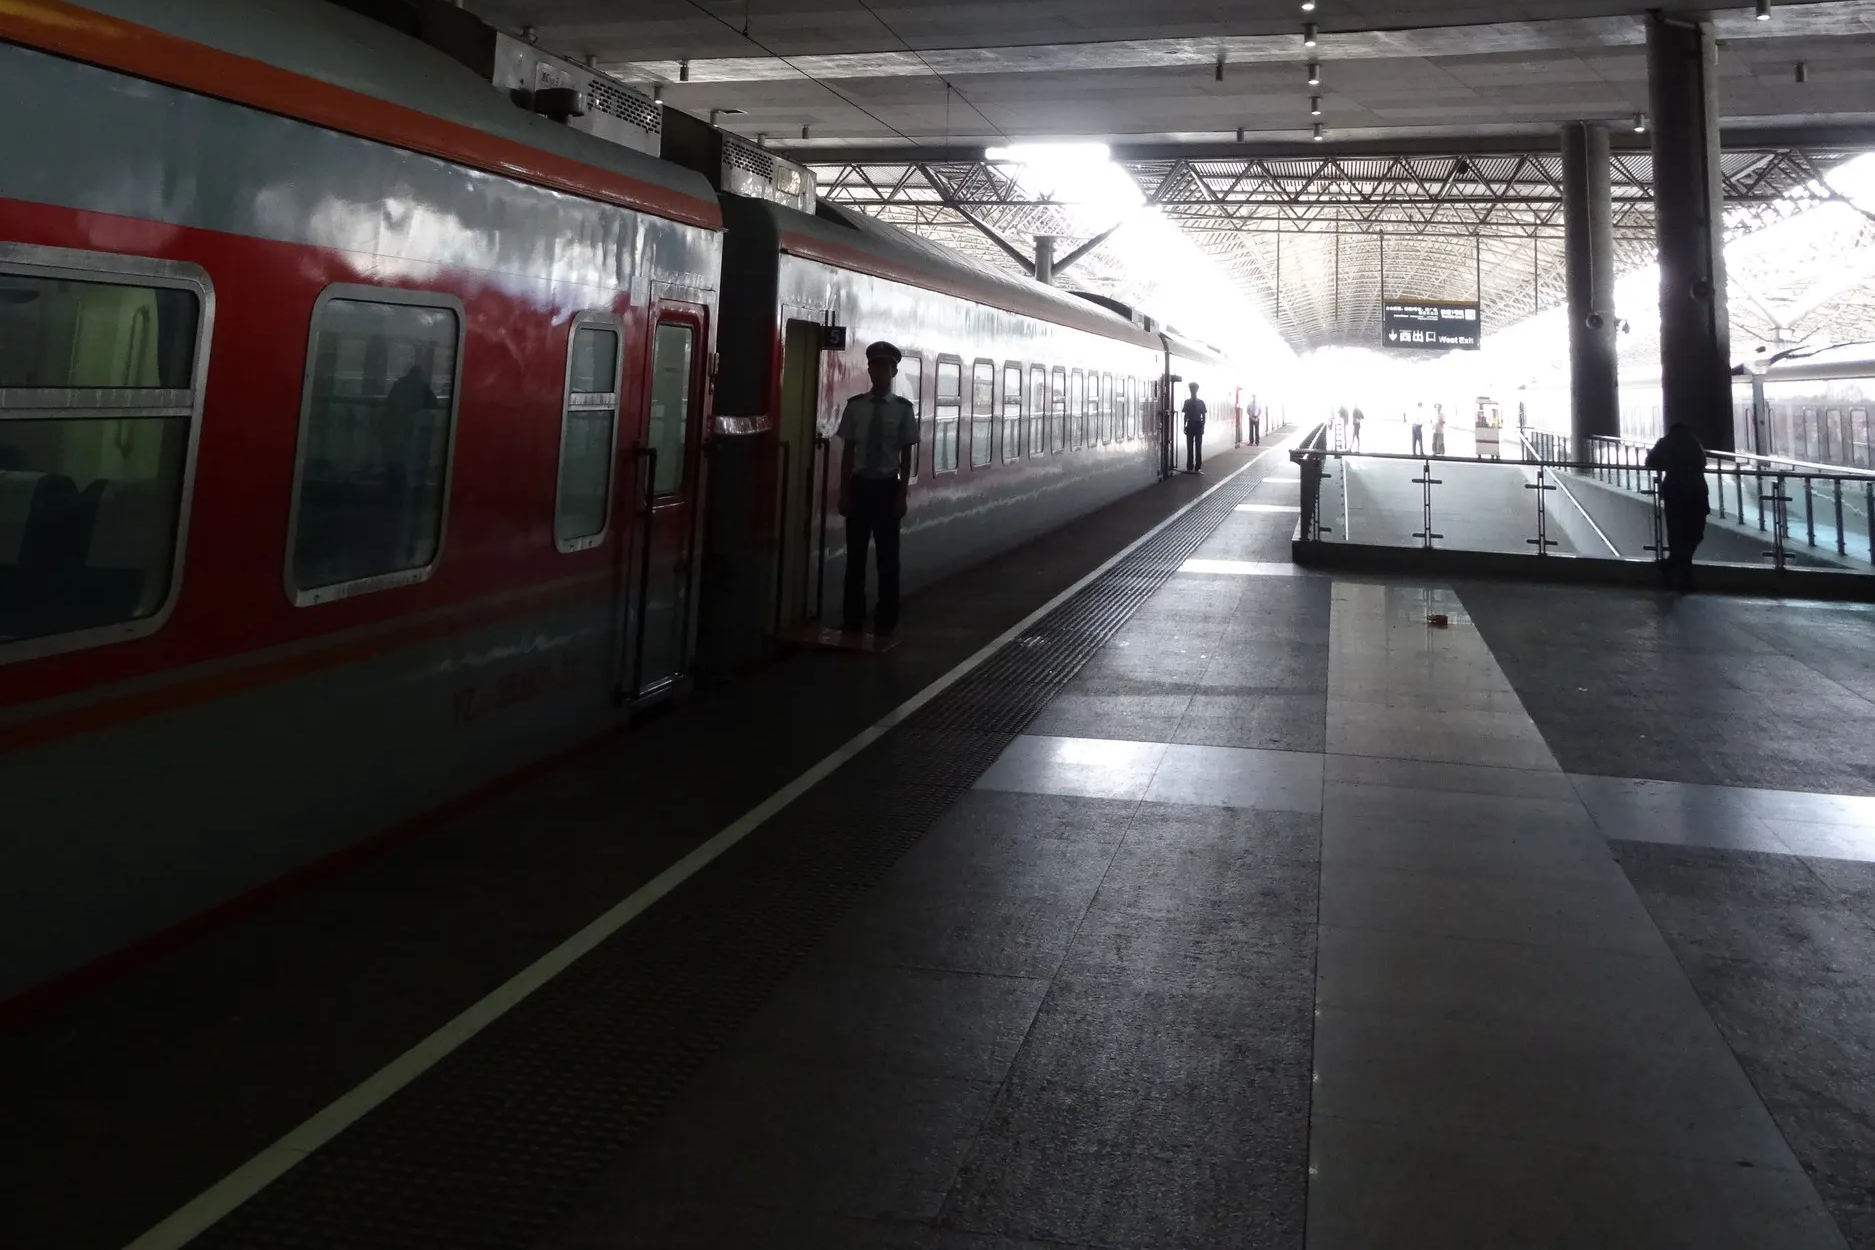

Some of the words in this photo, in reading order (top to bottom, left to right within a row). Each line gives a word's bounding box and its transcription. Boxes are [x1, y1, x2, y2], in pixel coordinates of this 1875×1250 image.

[1399, 329, 1436, 343] 西出口
[1438, 335, 1458, 345] West
[1459, 336, 1475, 345] Exit
